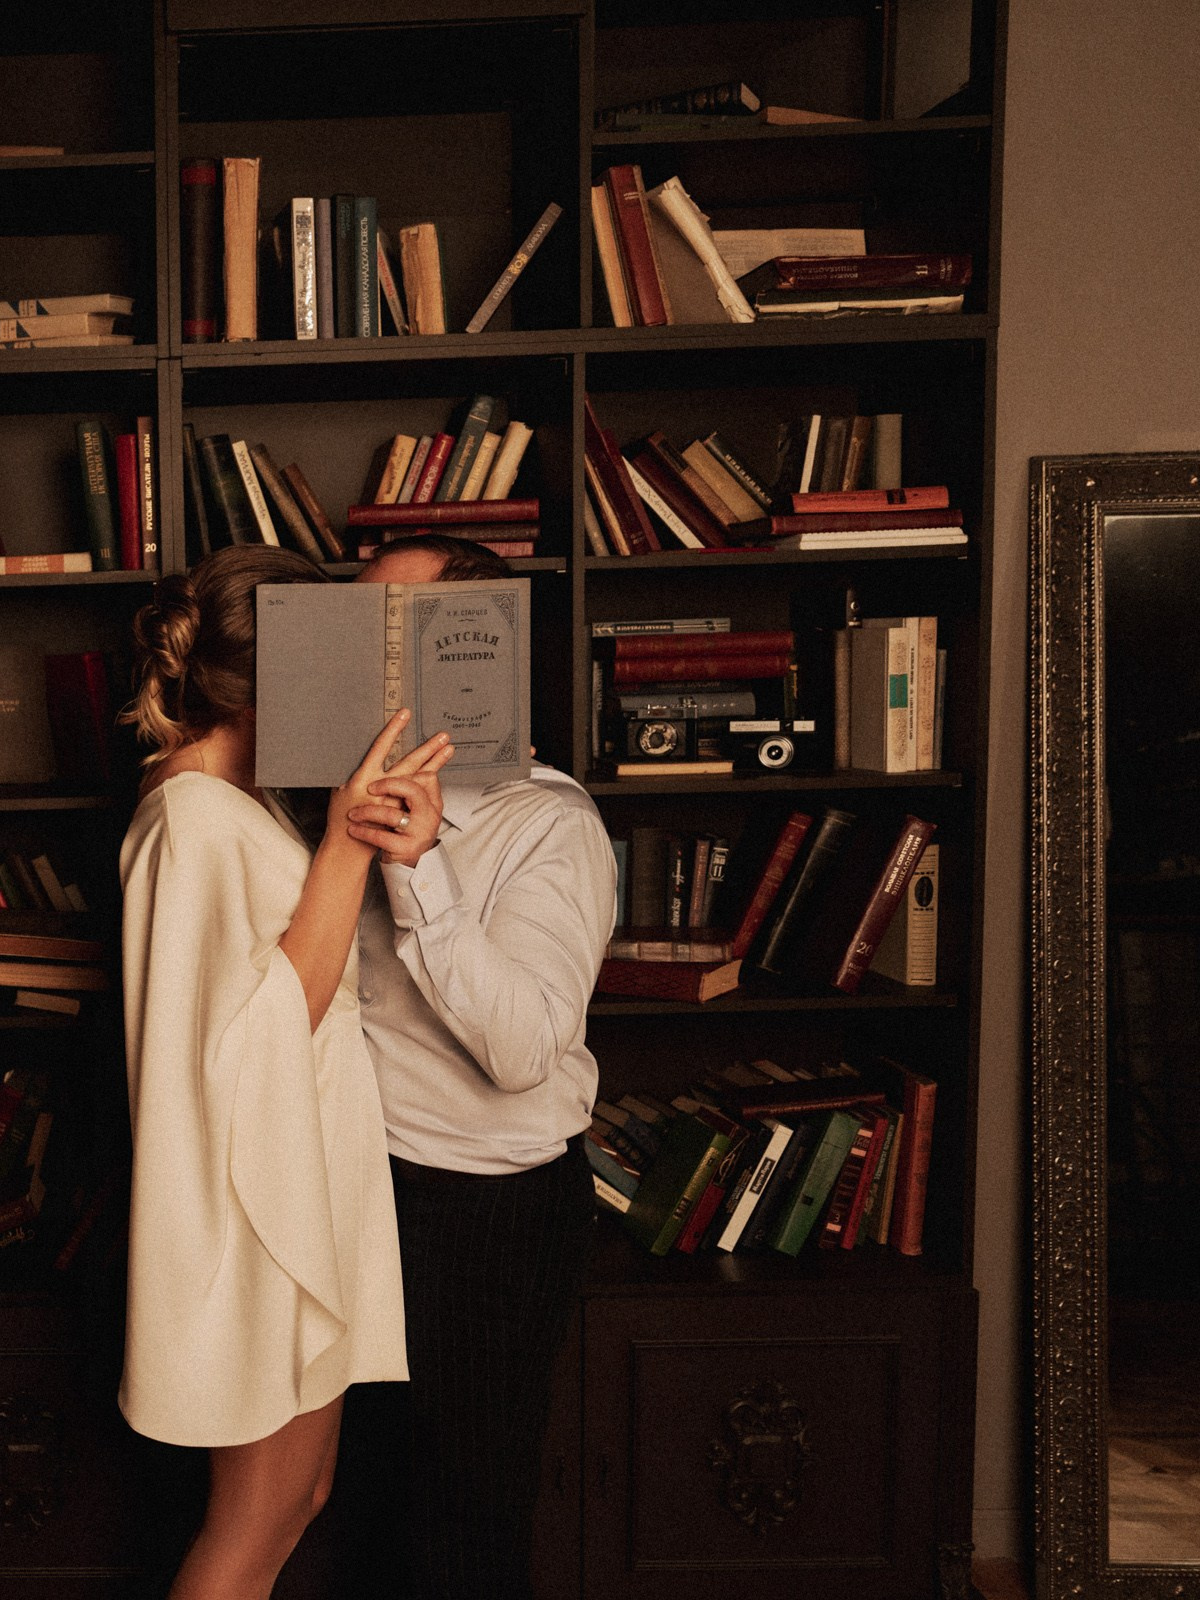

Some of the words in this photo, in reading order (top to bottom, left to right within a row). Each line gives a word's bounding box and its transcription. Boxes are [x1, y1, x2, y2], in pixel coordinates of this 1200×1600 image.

[360, 216, 368, 246] ПОВЕСТЬ
[144, 543, 158, 554] 20
[434, 631, 499, 652] ДЕТСКАЯ
[438, 652, 495, 661] ЛИТЕРАТУРА
[884, 866, 899, 893] БОЛЬШАЯ
[896, 833, 914, 866] СОВЕТСКАЯ
[889, 835, 922, 896] ЭНЦИКЛОПЕДИЯ
